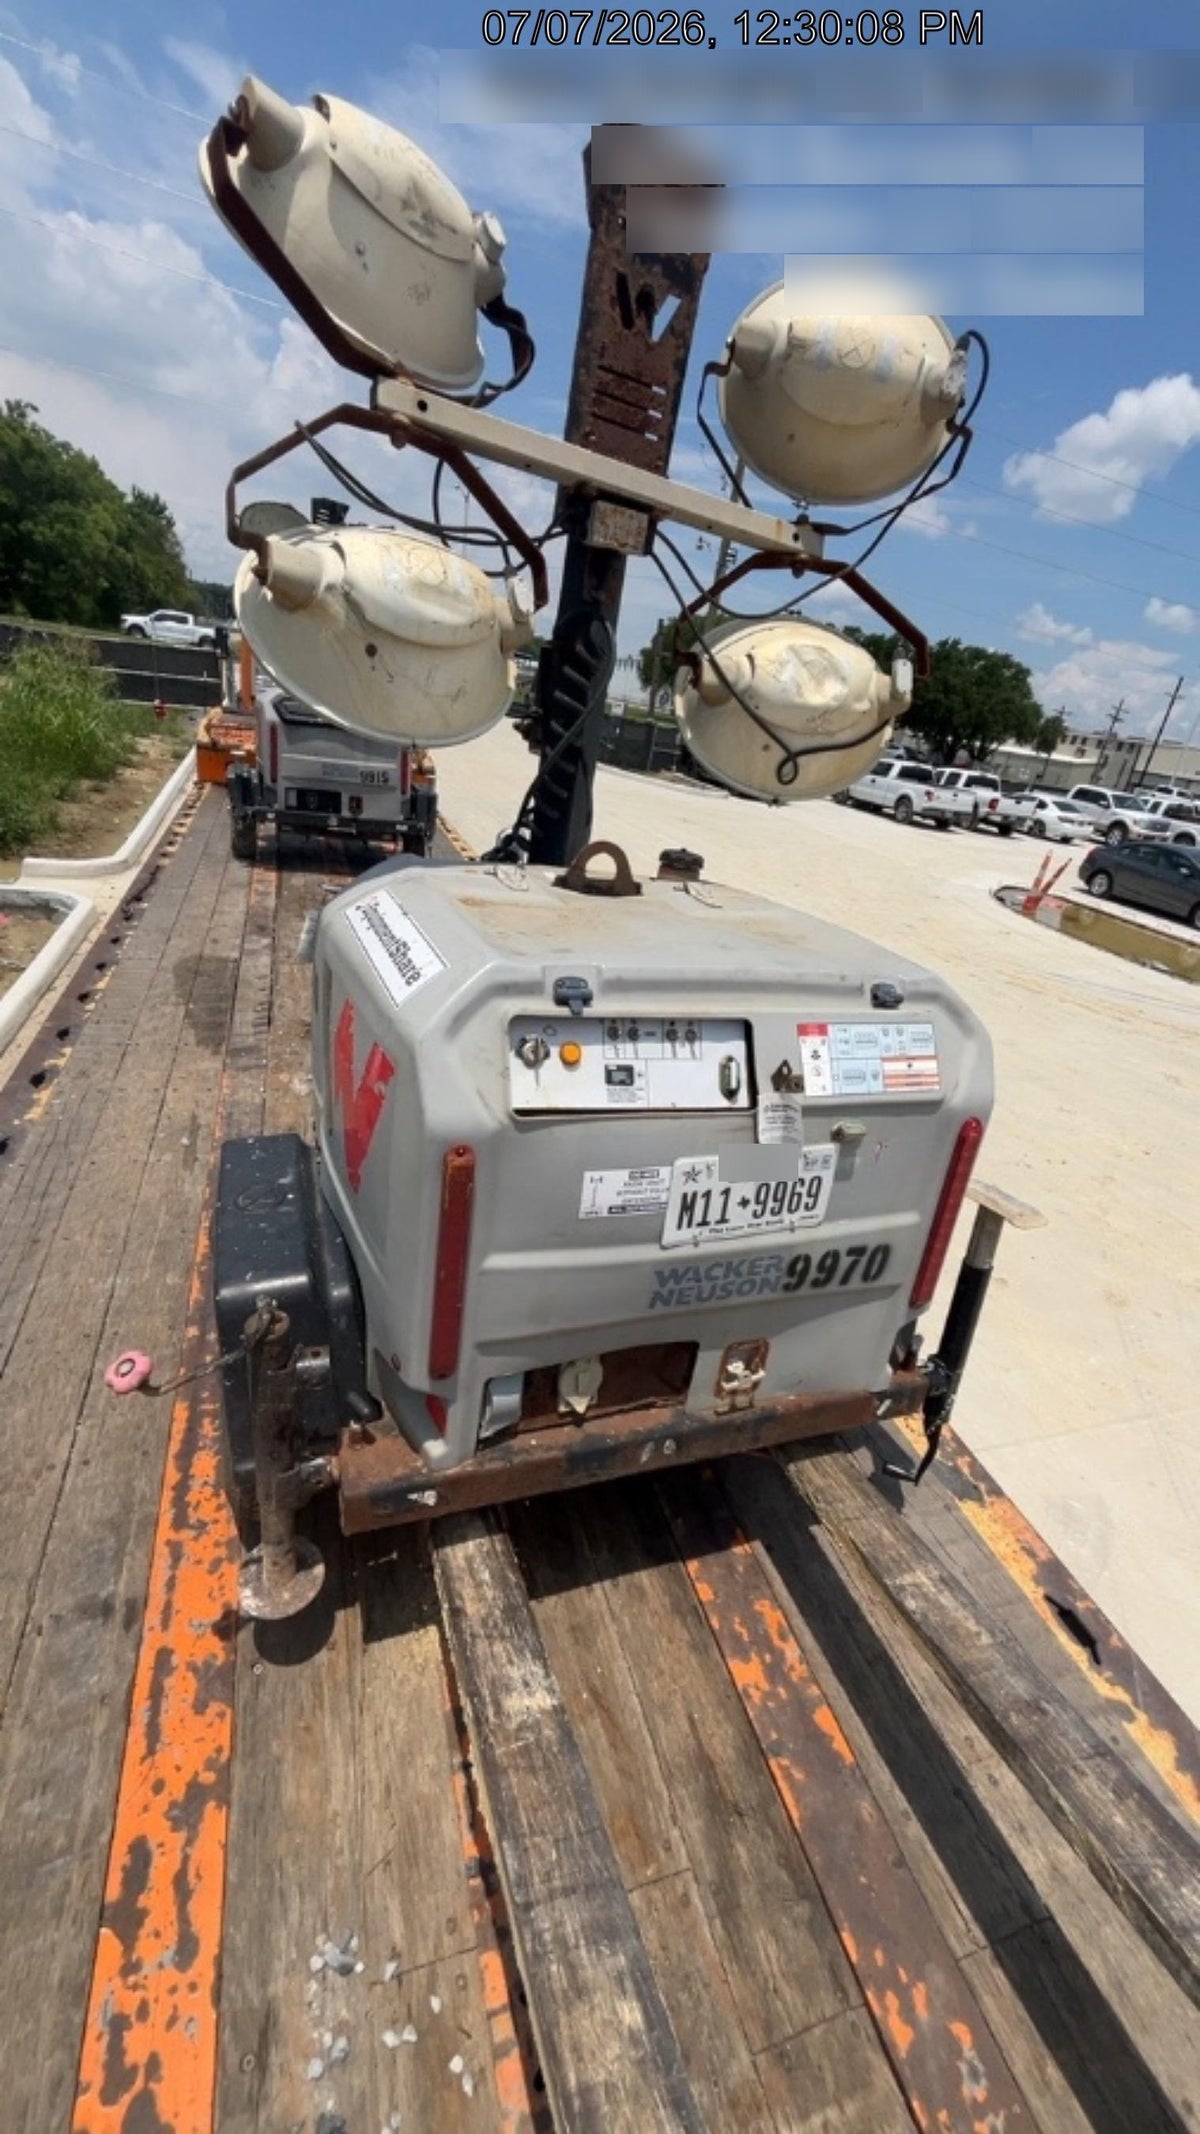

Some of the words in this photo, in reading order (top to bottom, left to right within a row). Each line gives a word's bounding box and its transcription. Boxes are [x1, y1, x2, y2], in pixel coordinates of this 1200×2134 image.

[653, 1254, 784, 1289] WACKER
[782, 1244, 892, 1293] 9970
[648, 1275, 783, 1309] NEUSON
